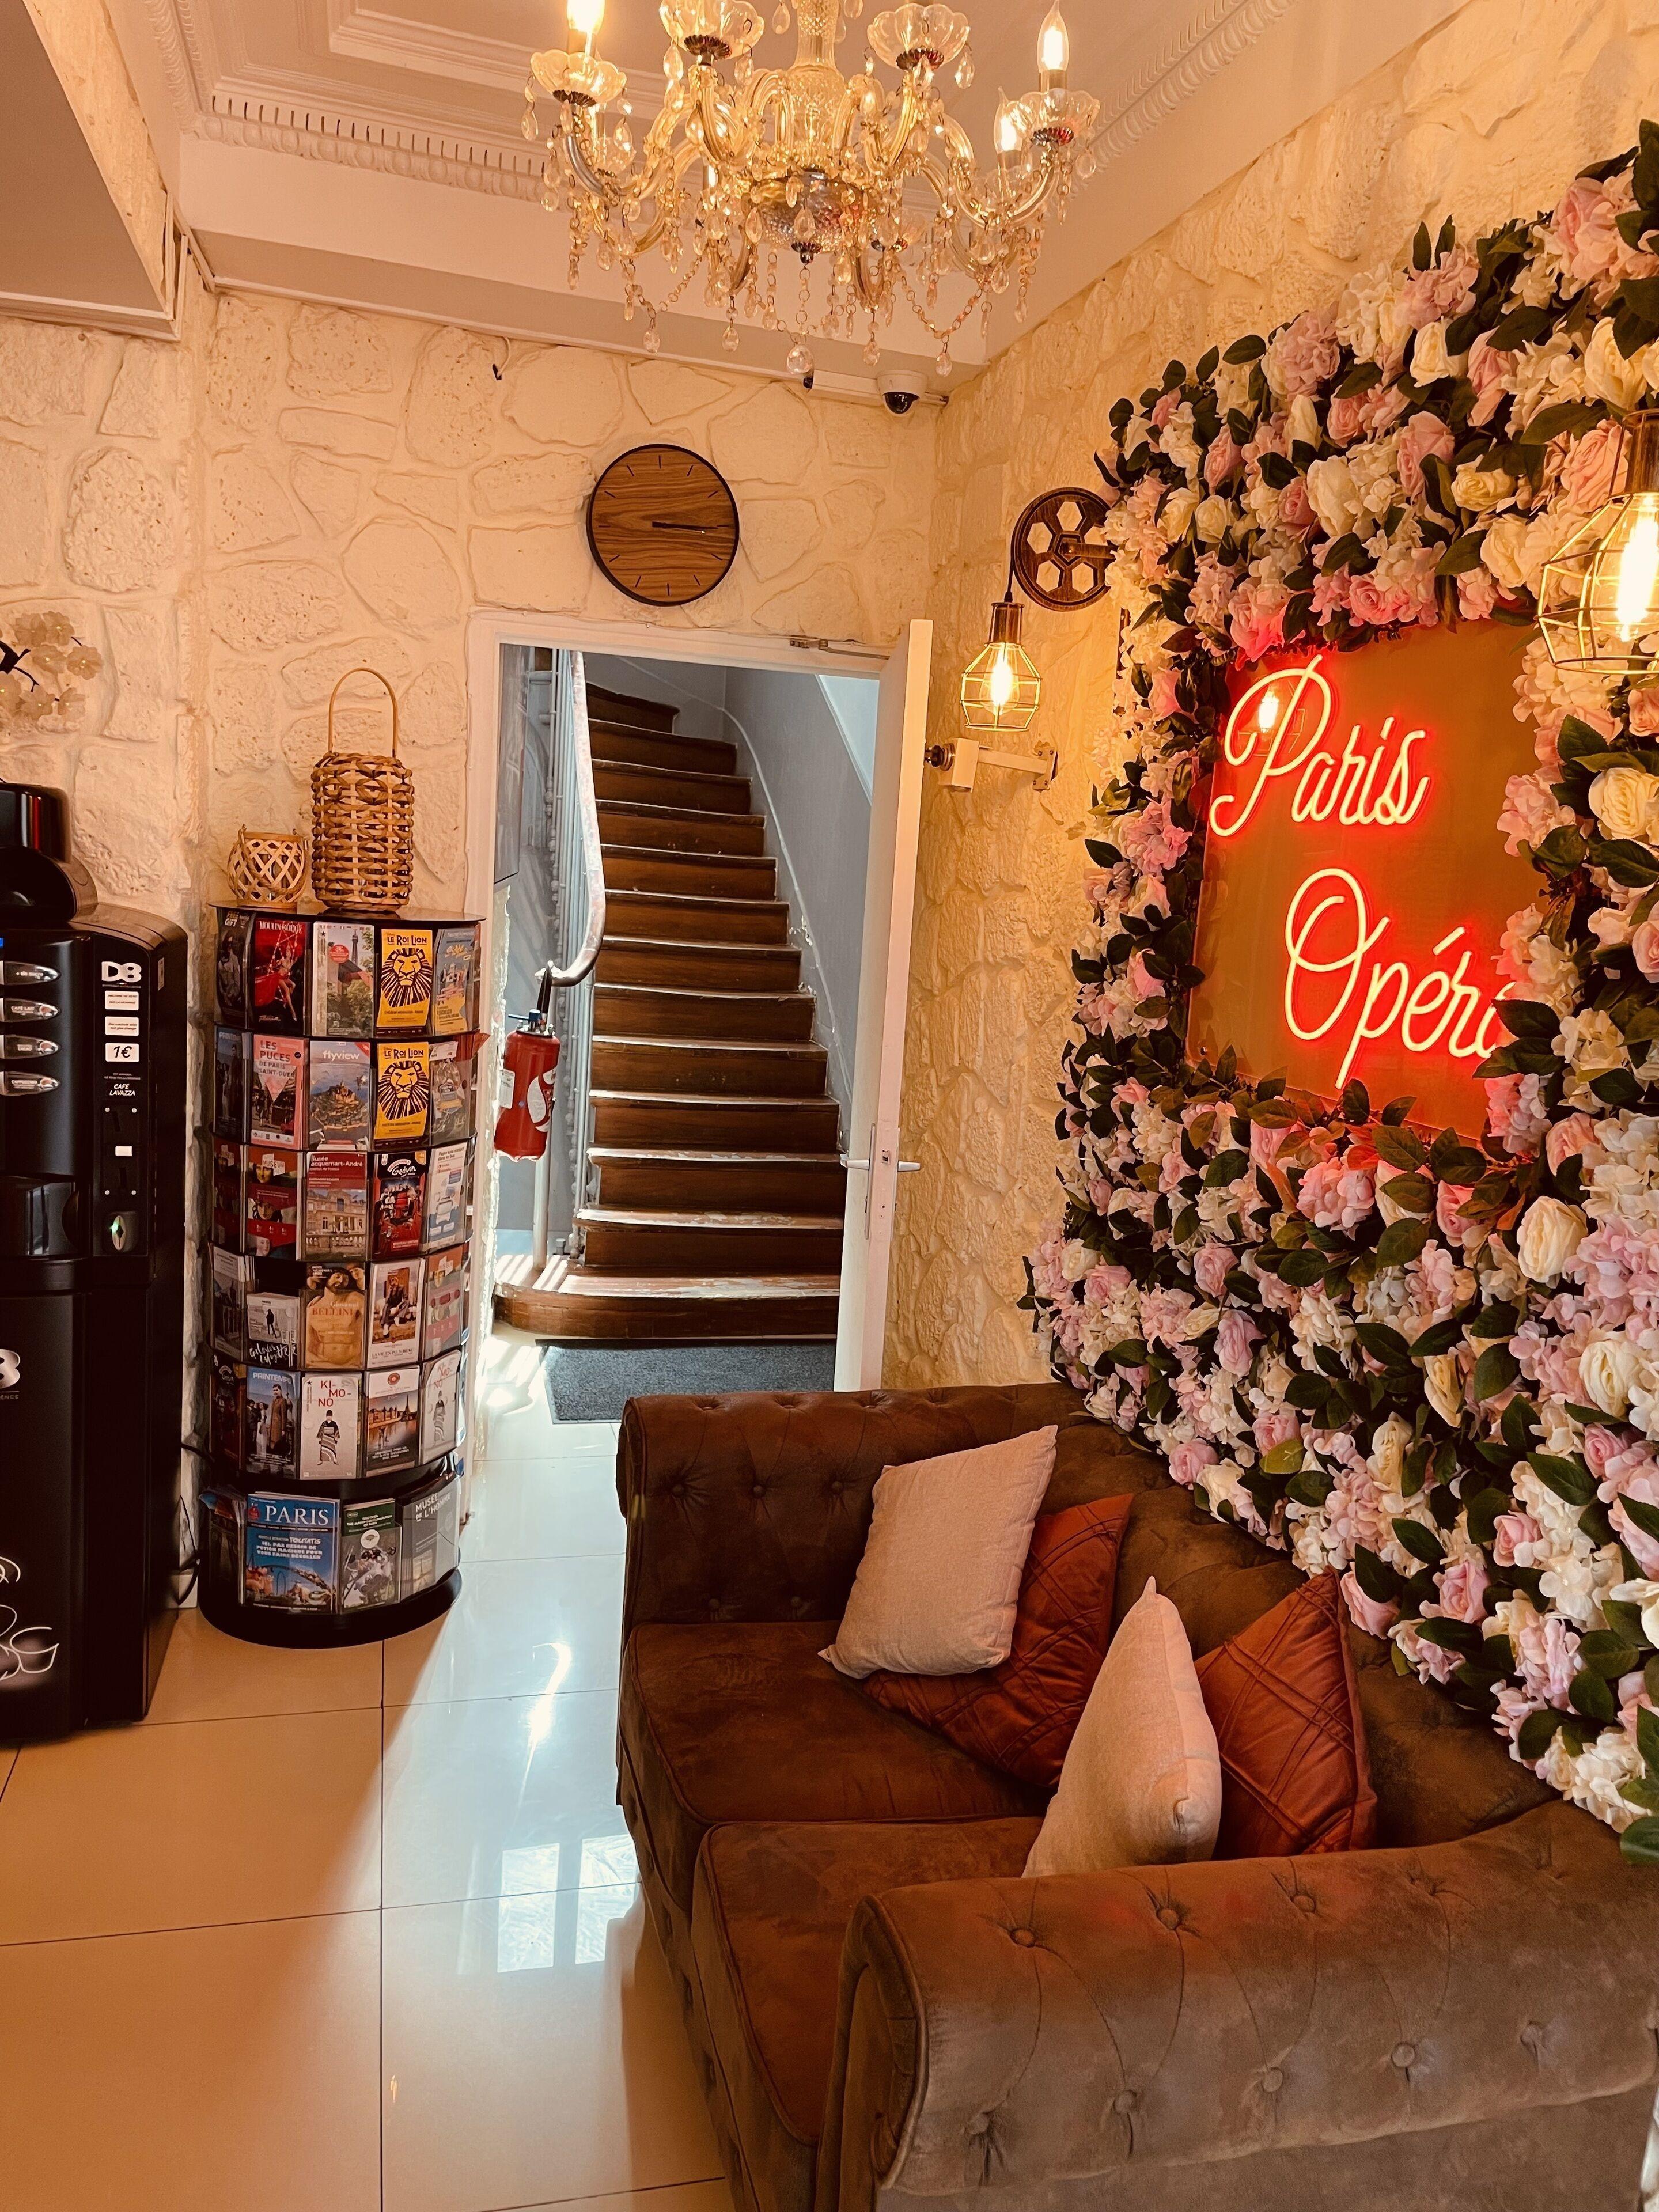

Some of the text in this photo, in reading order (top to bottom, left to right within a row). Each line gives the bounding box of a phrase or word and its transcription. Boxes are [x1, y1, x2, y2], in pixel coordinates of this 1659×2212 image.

[1209, 654, 1431, 836] Paris
[259, 921, 303, 934] MOULIN ROUGE
[101, 961, 142, 983] D8
[260, 1040, 277, 1050] LES
[113, 1046, 132, 1058] 1€
[260, 1050, 290, 1062] PUCES
[323, 1050, 359, 1062] flyview
[312, 1308, 353, 1316] BELLINI
[318, 1398, 334, 1407] NO
[415, 1492, 438, 1513] MUSÉE
[264, 1505, 329, 1526] PARIS
[289, 1536, 321, 1544] TOUTATIS
